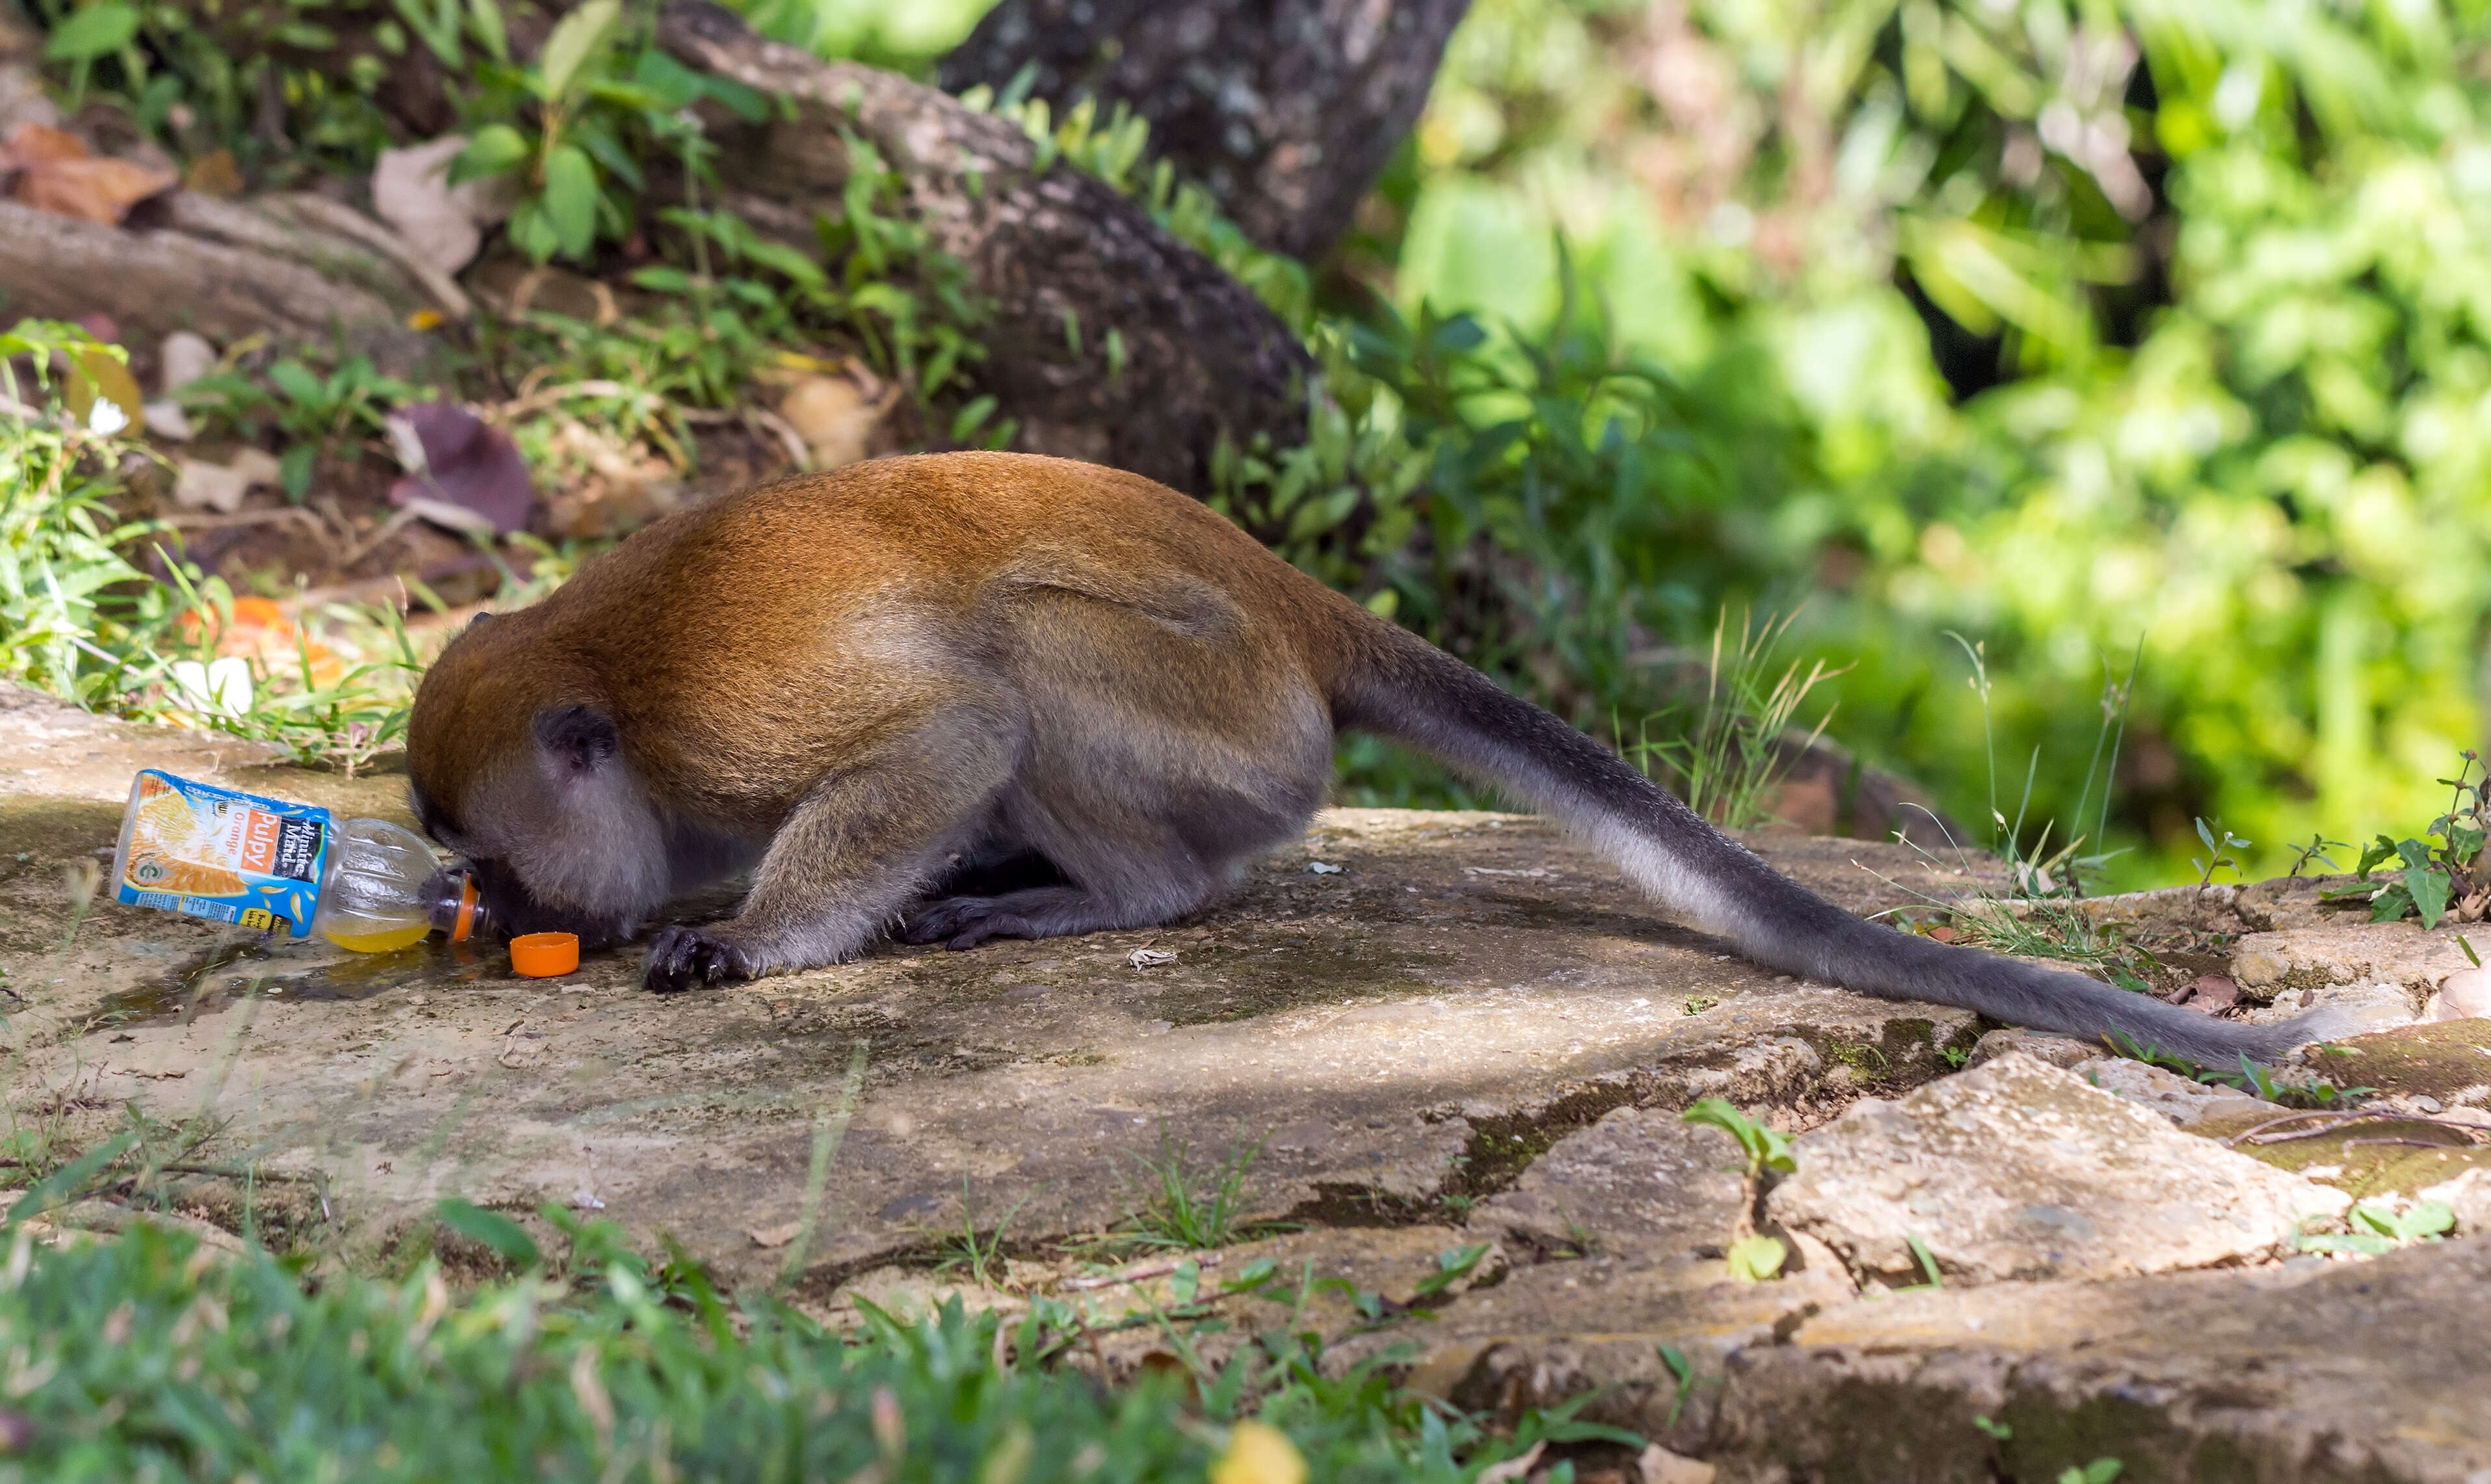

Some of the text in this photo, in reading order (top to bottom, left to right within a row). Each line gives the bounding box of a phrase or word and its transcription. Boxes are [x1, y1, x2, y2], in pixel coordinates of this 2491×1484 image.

[225, 812, 245, 855] Orange
[244, 812, 278, 868] Pulpy
[281, 824, 301, 864] Maid
[295, 821, 315, 874] Minute
